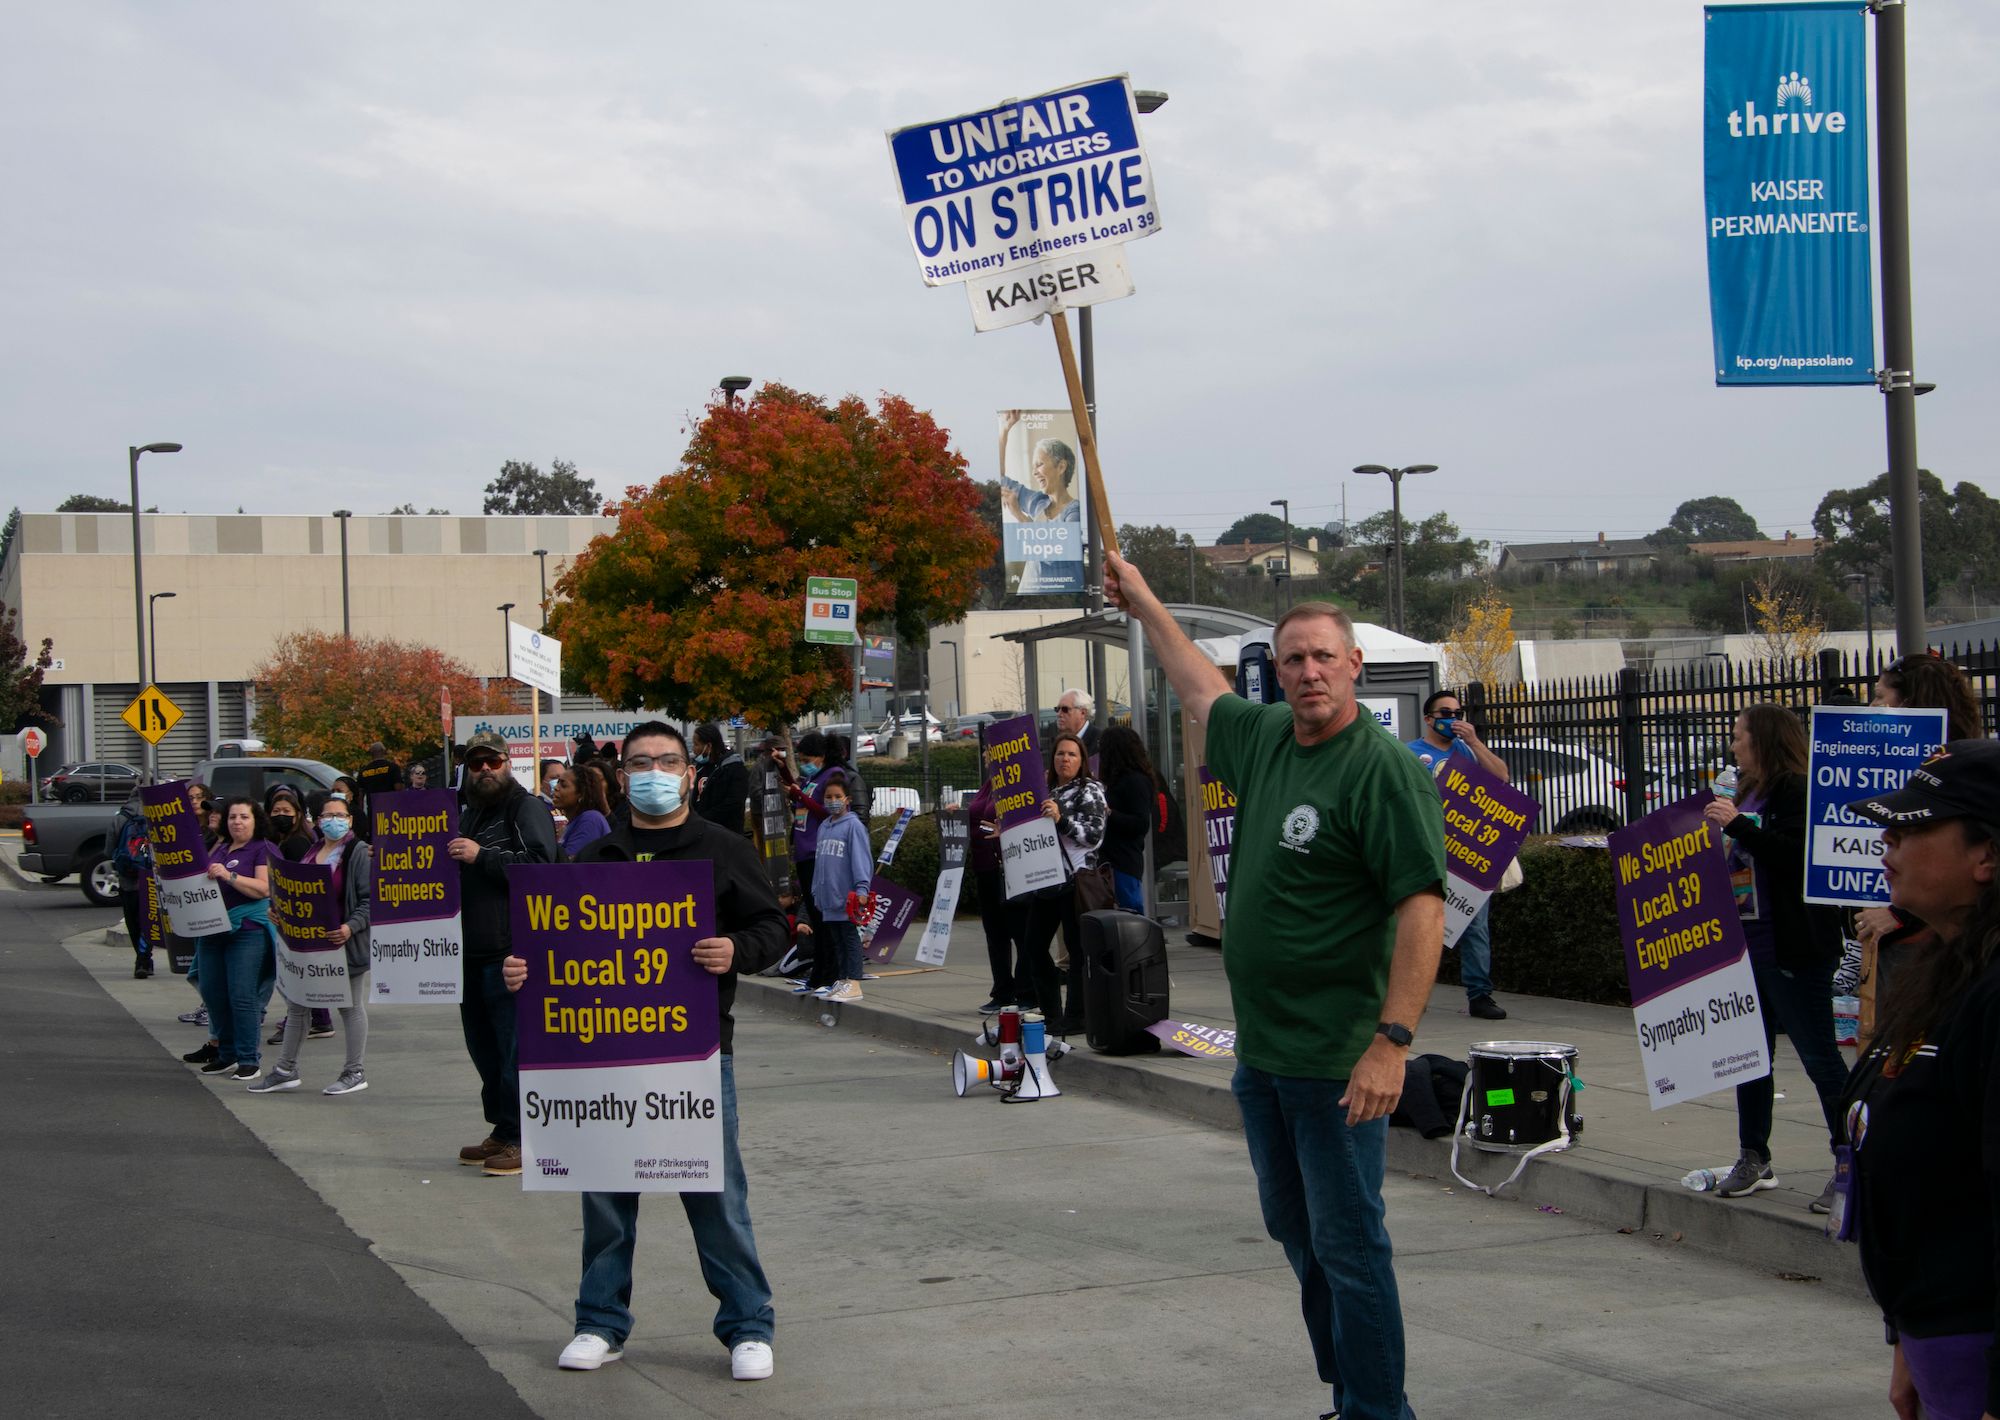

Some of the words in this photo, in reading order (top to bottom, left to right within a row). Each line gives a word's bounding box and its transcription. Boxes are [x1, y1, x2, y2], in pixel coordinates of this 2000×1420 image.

[929, 94, 1095, 164] UNFAIR
[1728, 100, 1846, 137] thrive
[926, 168, 965, 193] TO
[968, 131, 1111, 182] WORKERS
[1751, 180, 1824, 202] KAISER
[914, 195, 977, 258] ON
[991, 155, 1146, 240] STRIKE
[925, 252, 1006, 278] Stationary
[1009, 227, 1087, 261] Engineers
[1091, 218, 1133, 241] Local
[1137, 211, 1155, 230] 39
[986, 263, 1100, 312] KAISER
[1736, 355, 1854, 370] kp.org/napasolano
[1016, 527, 1068, 540] more
[1023, 542, 1063, 558] hope
[812, 587, 829, 595] Bus
[831, 588, 852, 598] Stop
[818, 605, 825, 613] 5
[836, 606, 846, 614] 7A
[56, 661, 63, 669] 2
[1842, 719, 1912, 737] Stationary
[26, 738, 40, 749] STOP
[1813, 740, 1880, 758] Engineers,
[1884, 743, 1919, 756] Local
[1007, 764, 1021, 784] 39
[1817, 766, 1850, 788] ON
[1446, 769, 1470, 797] We
[1470, 785, 1527, 831] Support
[1867, 802, 1932, 821] CORVETTE
[160, 824, 176, 844] 39
[376, 812, 390, 836] We
[391, 810, 448, 840] Support
[1477, 824, 1500, 847] 39
[1023, 835, 1055, 854] Strike
[1619, 853, 1640, 886] We
[1642, 820, 1711, 874] Support
[379, 846, 413, 871] Local
[416, 845, 434, 869] 39
[184, 887, 218, 905] Strike
[378, 878, 445, 908] Engineers
[1632, 882, 1679, 929] Local
[1682, 872, 1701, 908] 39
[296, 902, 313, 919] 39
[526, 894, 570, 931] We
[579, 893, 697, 940] Support
[372, 938, 420, 963] Sympathy
[423, 938, 459, 957] Strike
[1635, 918, 1723, 971] Engineers
[308, 963, 345, 977] Strike
[548, 949, 626, 986] Local
[634, 948, 668, 985] 39
[544, 997, 688, 1044] Engineers
[1640, 1007, 1706, 1052] Sympathy
[1710, 991, 1755, 1025] Strike
[1659, 1083, 1676, 1095] UHW
[526, 1090, 637, 1129] Sympathy
[645, 1091, 715, 1120] Strike
[542, 1167, 569, 1176] UHW
[634, 1159, 657, 1169] #BeKP
[658, 1158, 709, 1170] #Strikesgiving
[634, 1170, 709, 1180] #WeAreKaiserWorkers
